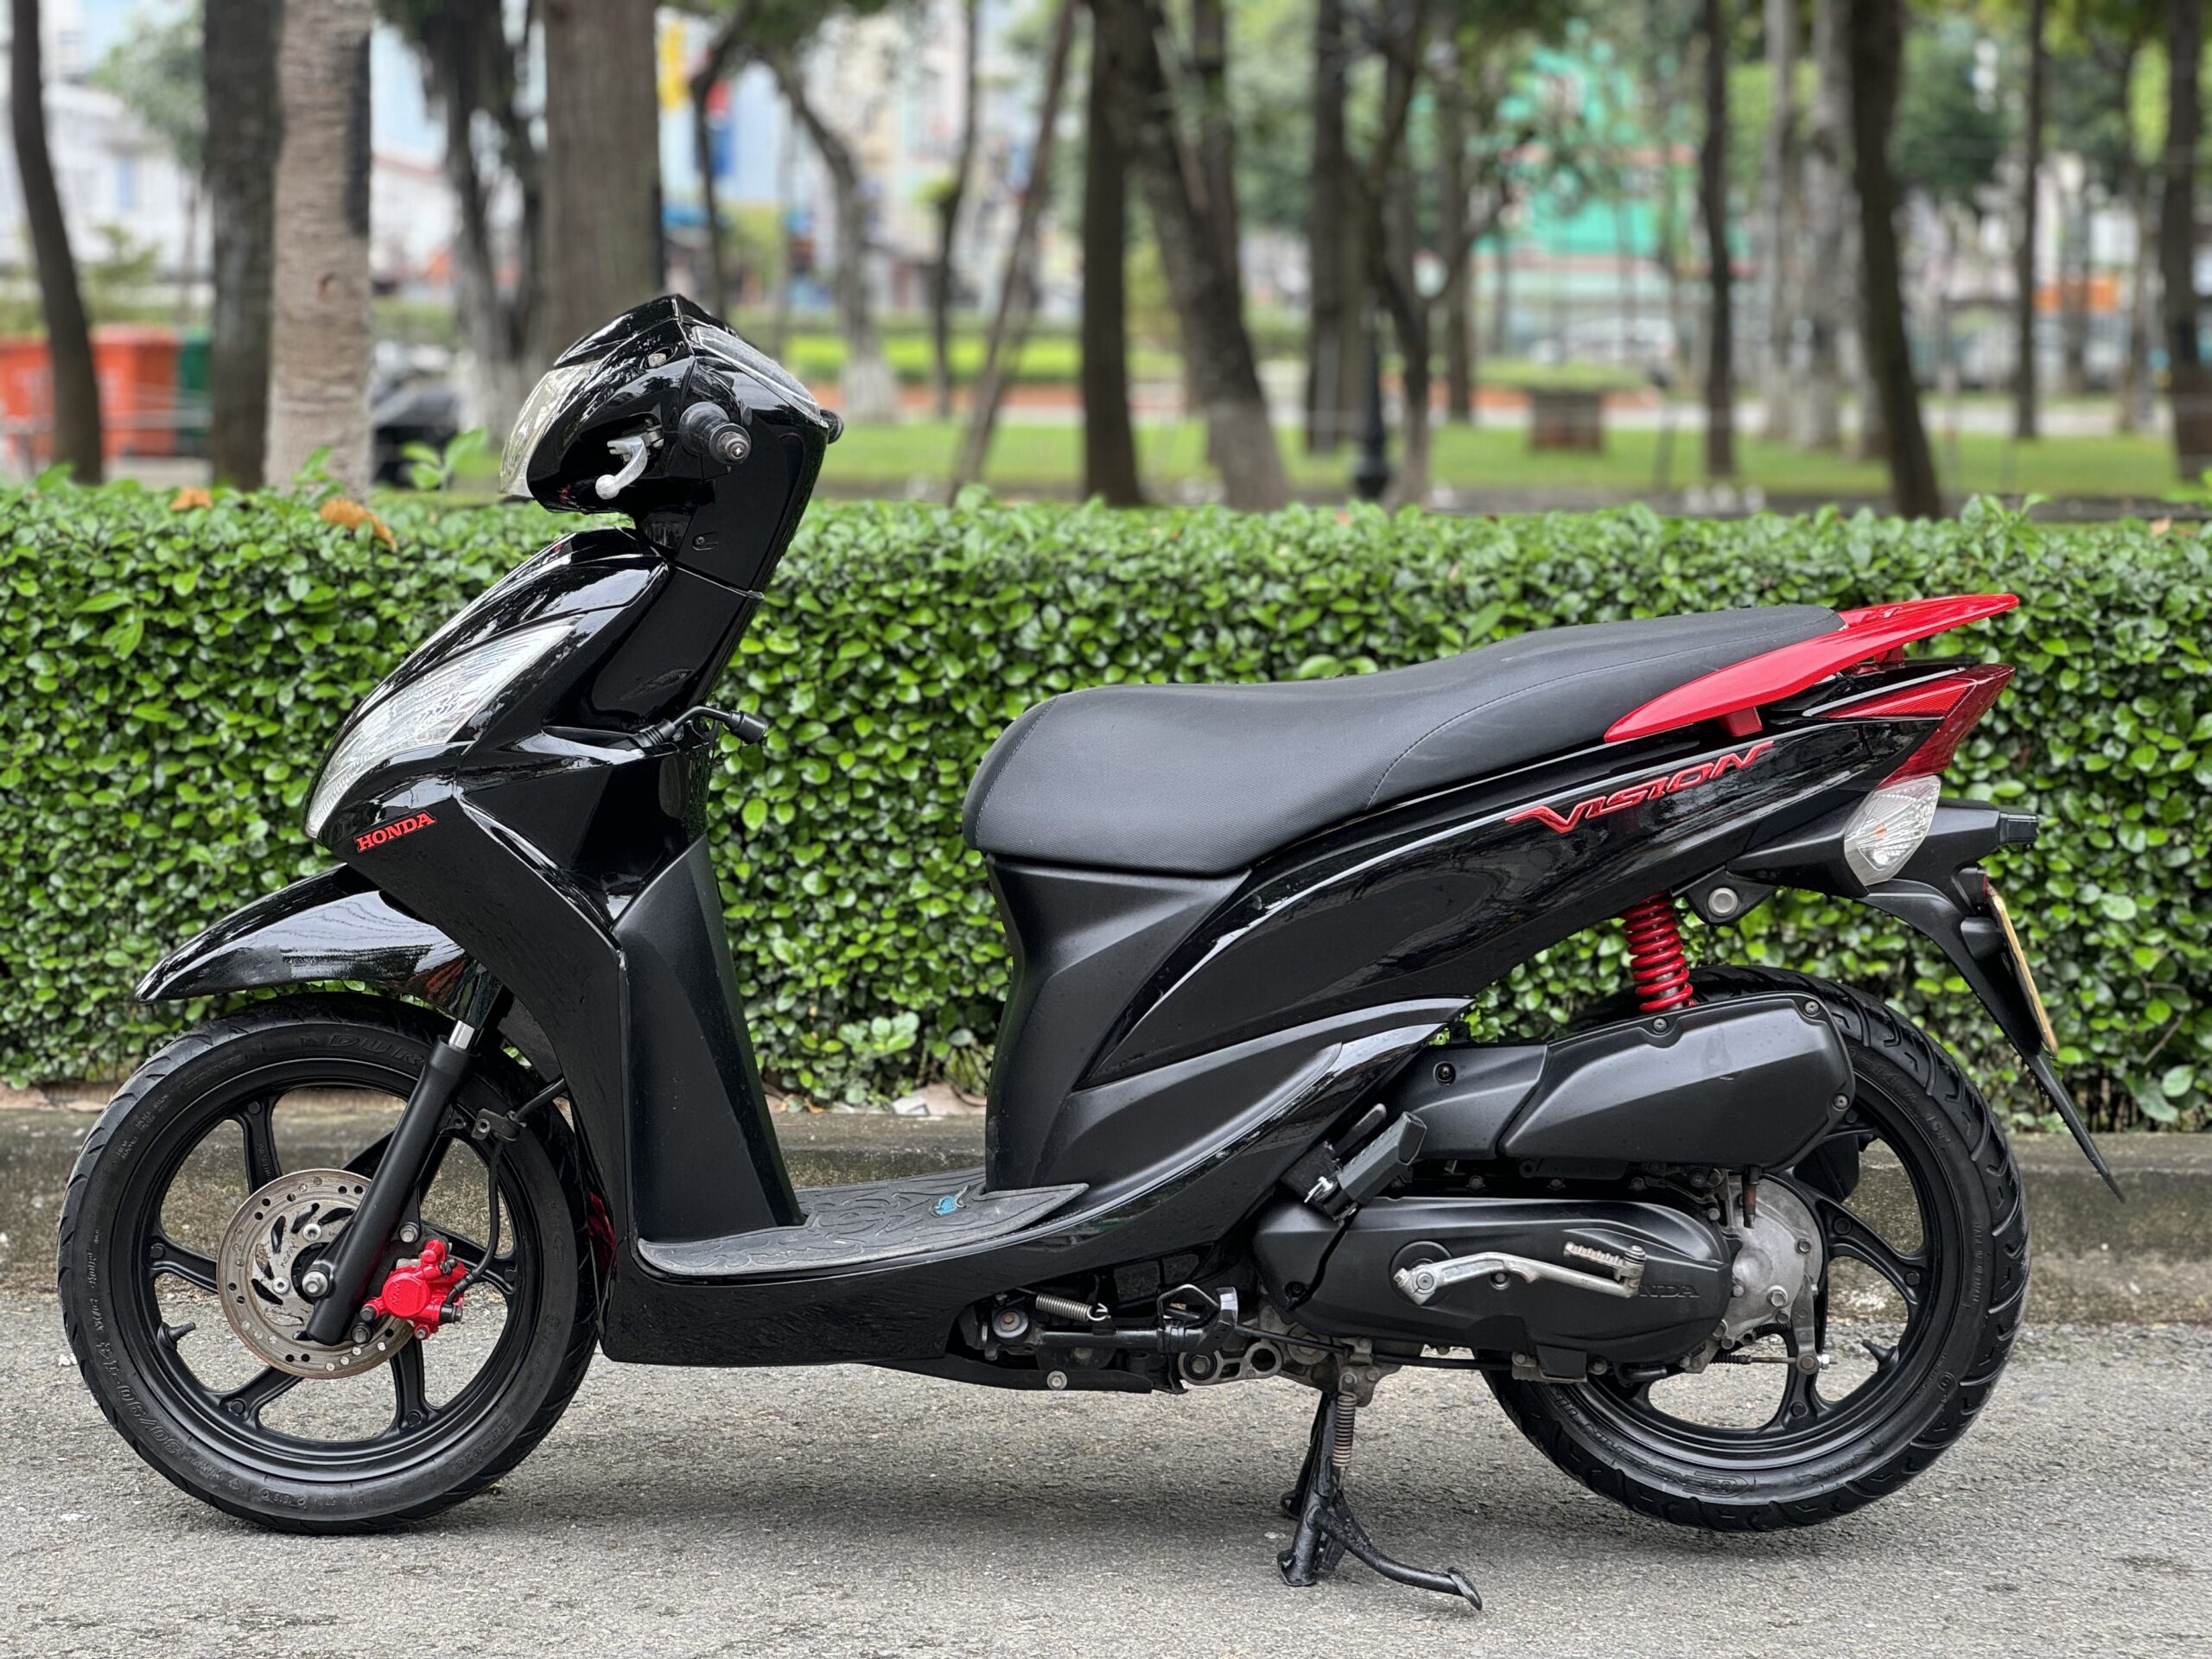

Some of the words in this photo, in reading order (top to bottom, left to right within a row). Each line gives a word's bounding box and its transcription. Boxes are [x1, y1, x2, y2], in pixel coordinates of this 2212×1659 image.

[1505, 740, 1774, 834] VISION
[356, 812, 435, 852] HONDA
[328, 1033, 426, 1065] DUR
[1638, 1284, 1700, 1298] NDA
